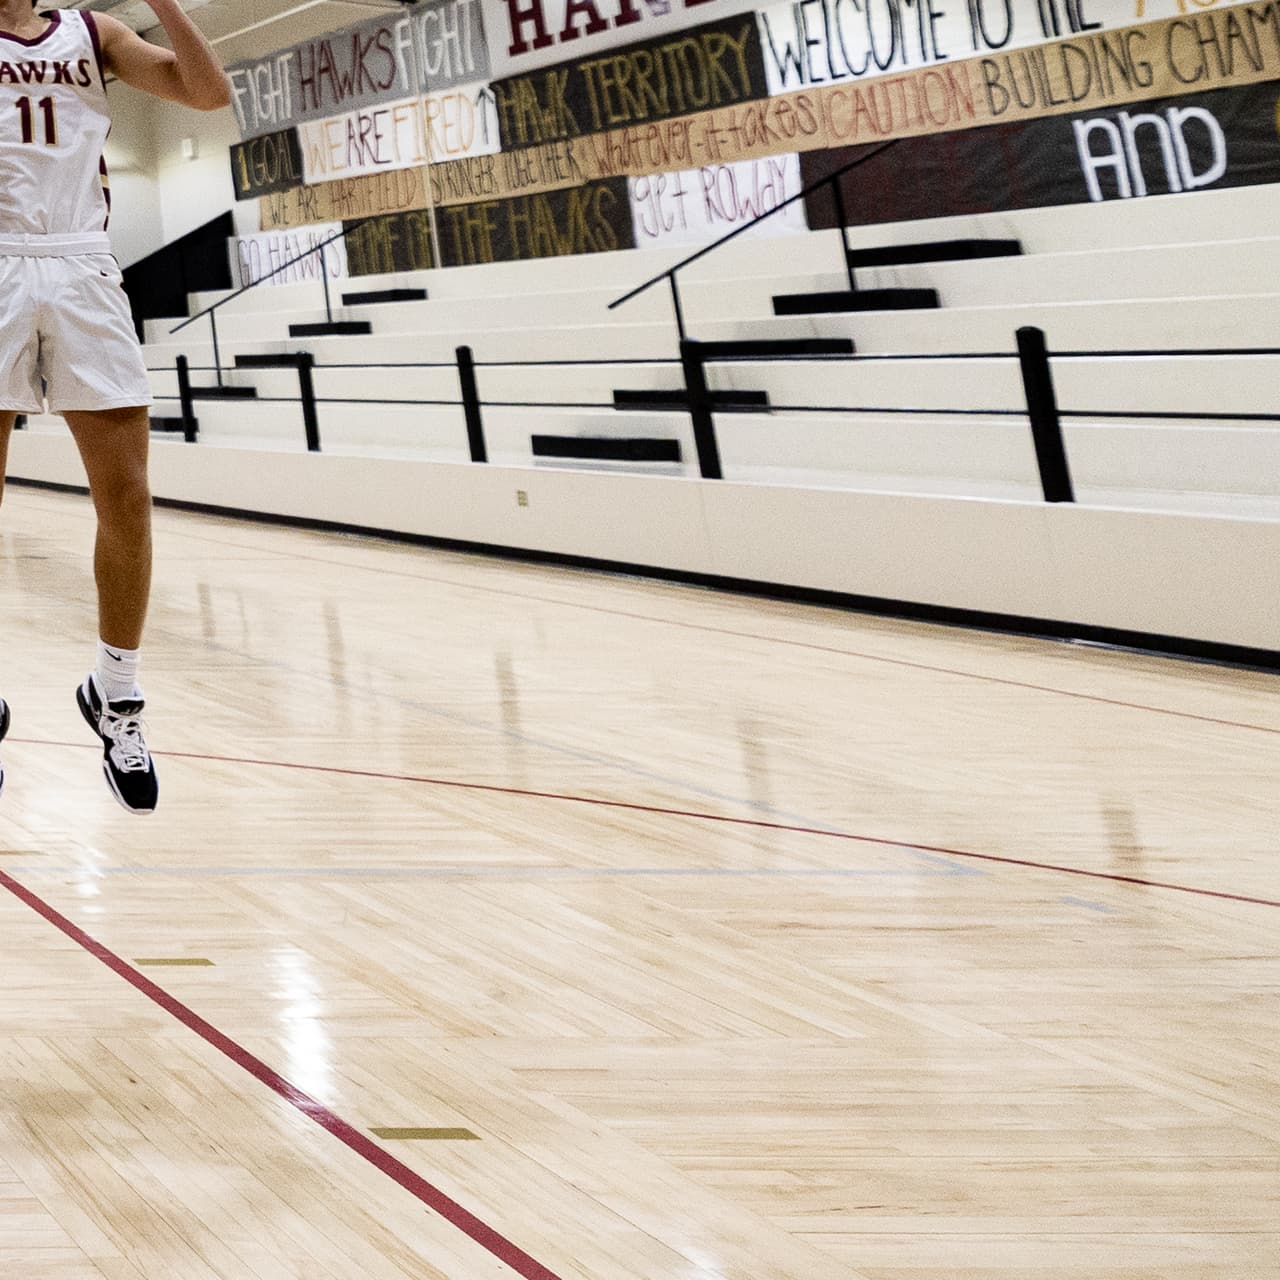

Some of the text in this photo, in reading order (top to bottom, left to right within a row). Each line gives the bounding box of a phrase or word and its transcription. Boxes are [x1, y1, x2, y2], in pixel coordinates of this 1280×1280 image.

[227, 52, 292, 131] FIGHT
[297, 28, 396, 112] HAWKS
[496, 23, 752, 144] HAWK TERRITORY
[826, 62, 977, 139] CAUTION
[981, 30, 1154, 116] BUILDING
[15, 95, 59, 146] 11
[250, 131, 302, 184] GOAL
[304, 92, 476, 176] WE ARE FIRED
[297, 183, 323, 220] ARE
[330, 168, 417, 217] HARTFIELD
[507, 185, 617, 259] HAWKS
[237, 228, 340, 288] GO HAWKS
